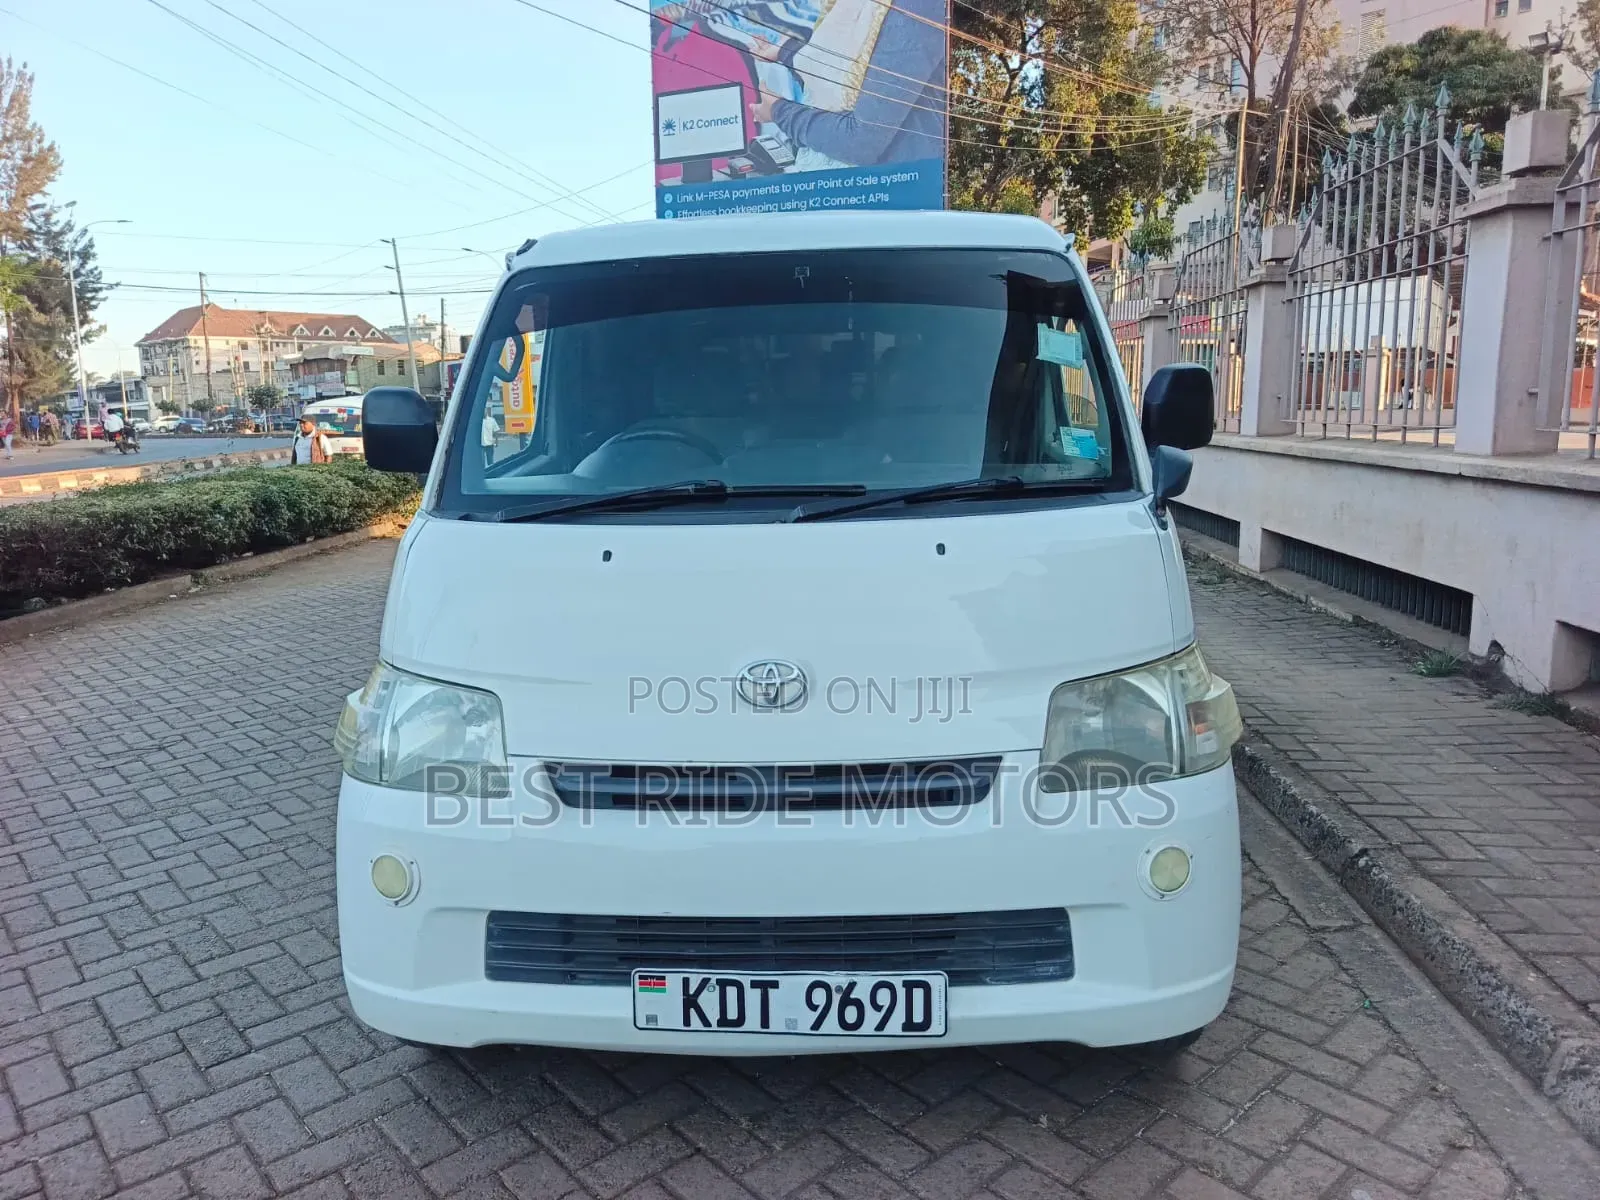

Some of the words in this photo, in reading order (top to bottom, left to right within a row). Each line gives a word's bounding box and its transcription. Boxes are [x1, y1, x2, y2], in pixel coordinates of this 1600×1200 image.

[682, 119, 695, 132] K2
[696, 114, 739, 129] Connect
[676, 193, 695, 203] Link
[695, 189, 731, 201] M-PESA
[732, 184, 780, 200] payments
[782, 183, 792, 193] to
[793, 181, 815, 194] your
[817, 178, 842, 189] Point
[844, 176, 854, 187] of
[856, 174, 879, 186] Sale
[880, 171, 919, 187] system
[677, 207, 717, 219] Effortless
[718, 202, 779, 216] bookkeeping
[781, 198, 807, 211] using
[809, 197, 821, 208] K2
[823, 194, 866, 207] Connect
[868, 191, 890, 203] APIs
[681, 975, 780, 1030] KDT
[804, 978, 933, 1033] 969D
